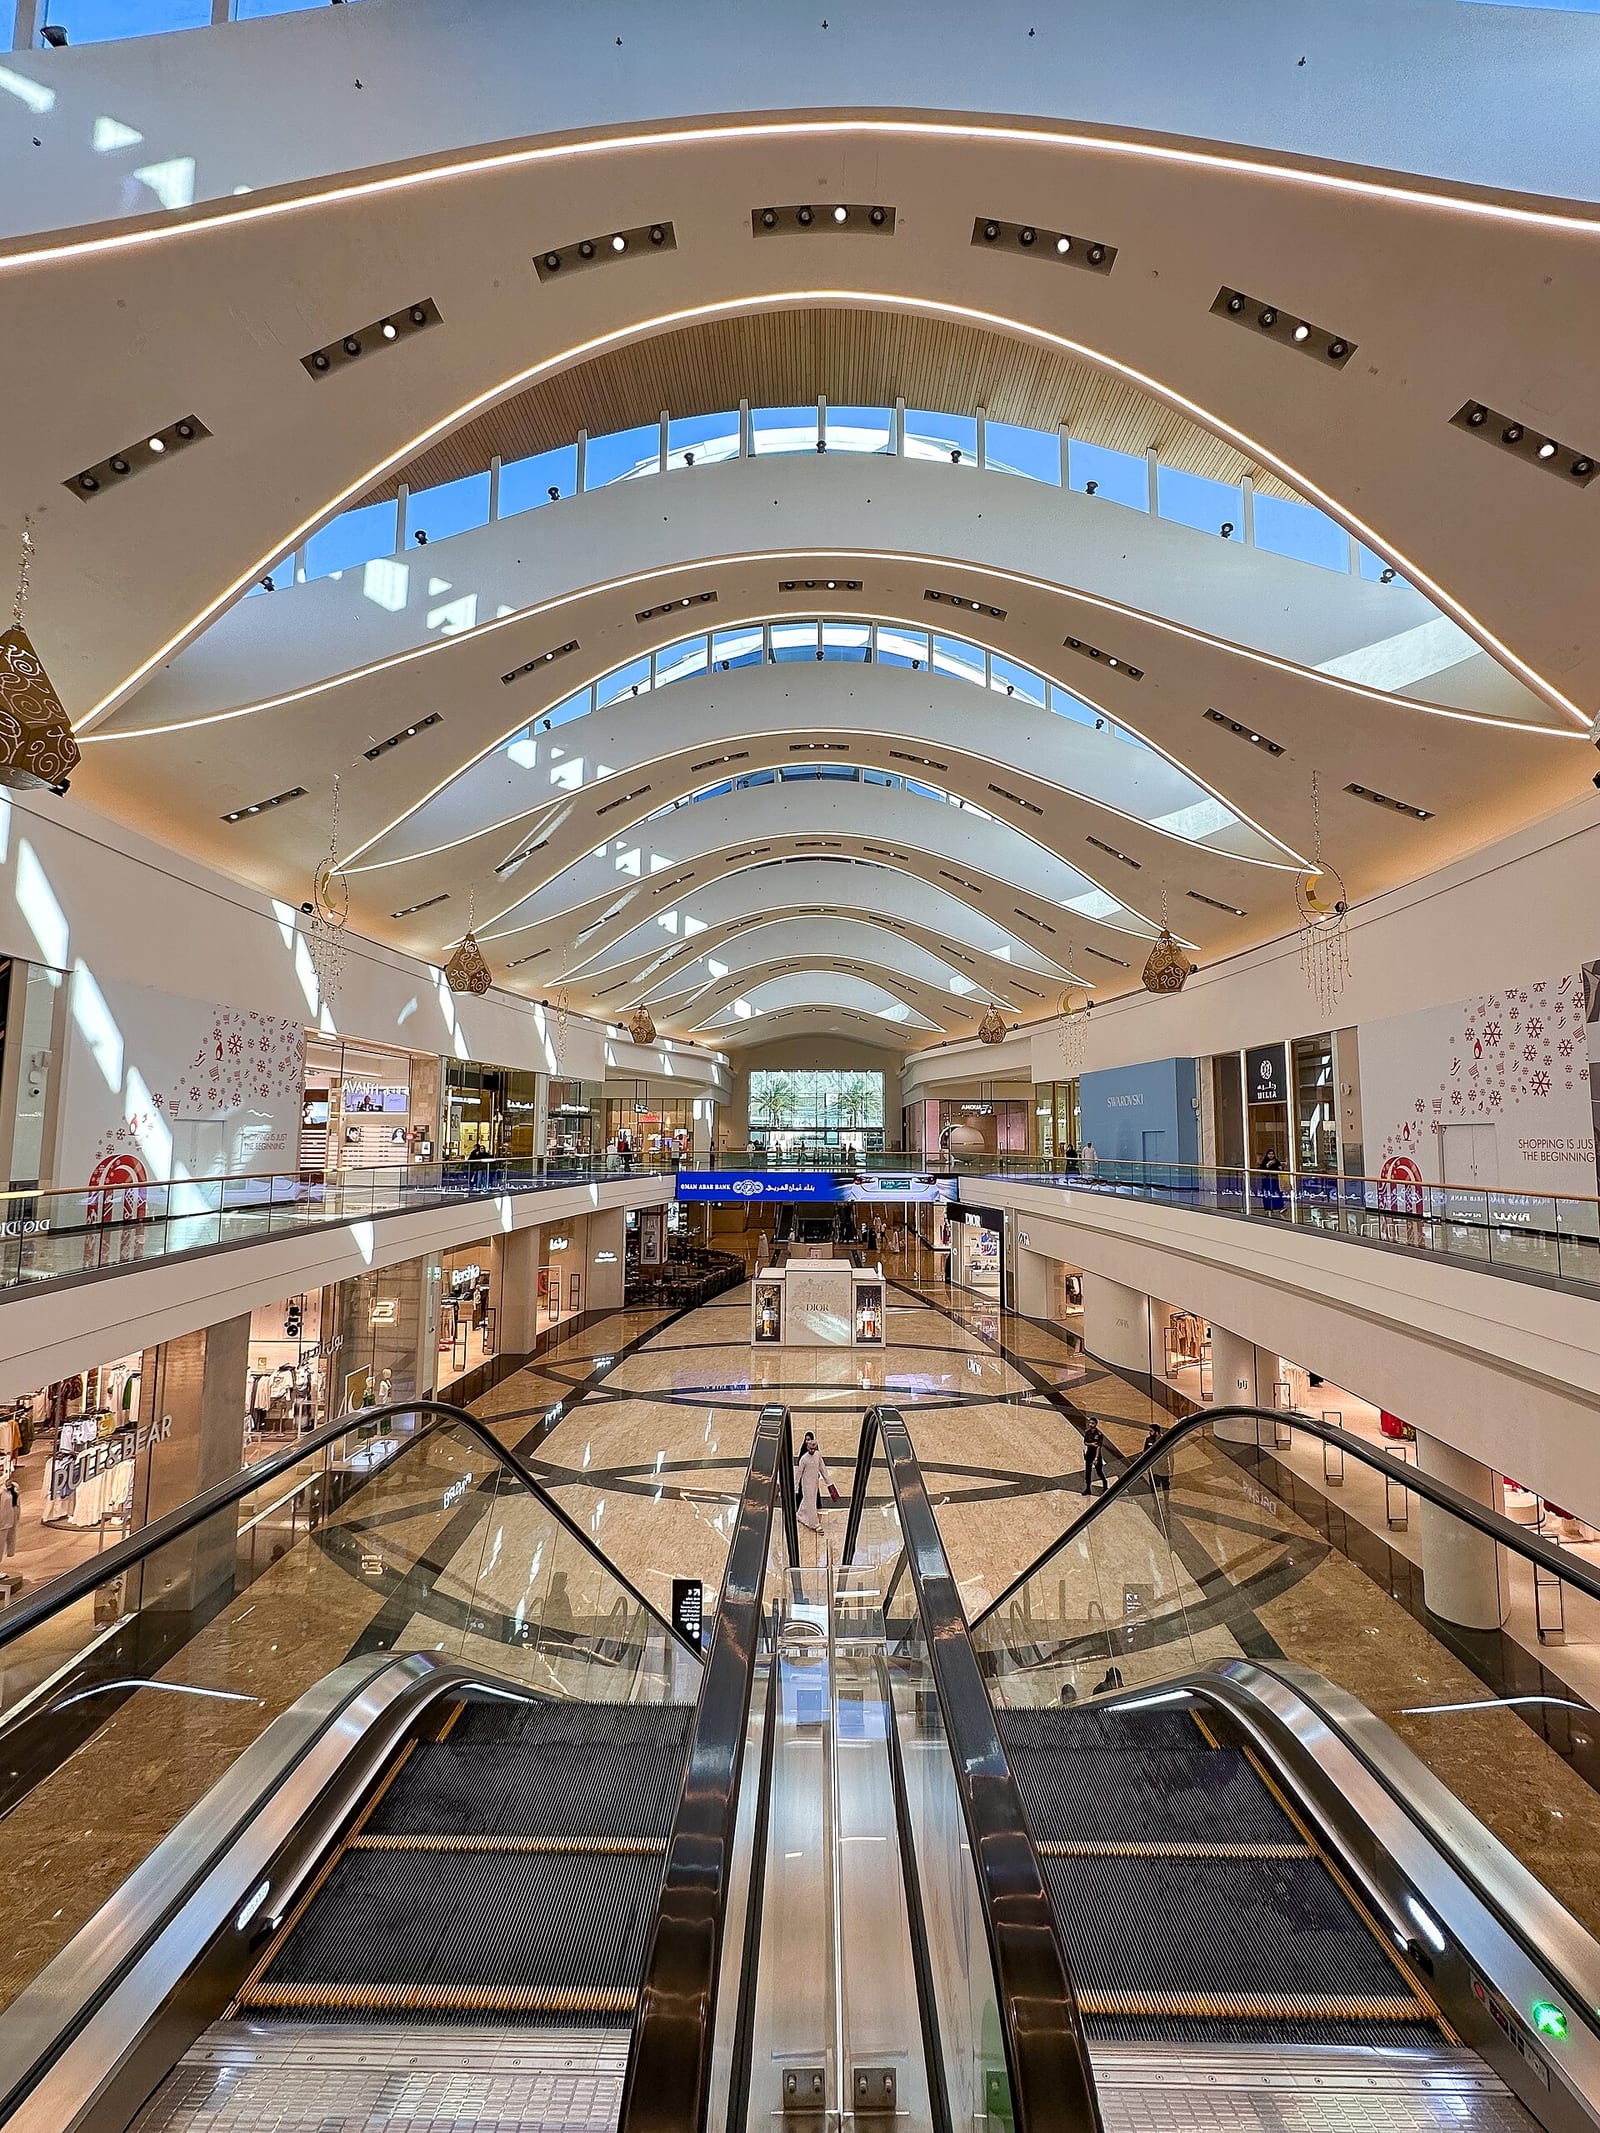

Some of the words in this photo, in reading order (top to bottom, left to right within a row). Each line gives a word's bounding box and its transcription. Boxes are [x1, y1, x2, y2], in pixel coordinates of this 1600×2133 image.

[1107, 1093, 1144, 1107] SWAROVSKI
[1518, 1139, 1564, 1149] SHOPPING
[1567, 1139, 1575, 1149] IS
[1577, 1139, 1594, 1149] JUS
[1522, 1151, 1538, 1161] THE
[1540, 1151, 1595, 1162] BEGINNING
[965, 1212, 981, 1228] DIOR
[806, 1303, 829, 1311] DIOR
[53, 1414, 173, 1501] PULL&BEAR
